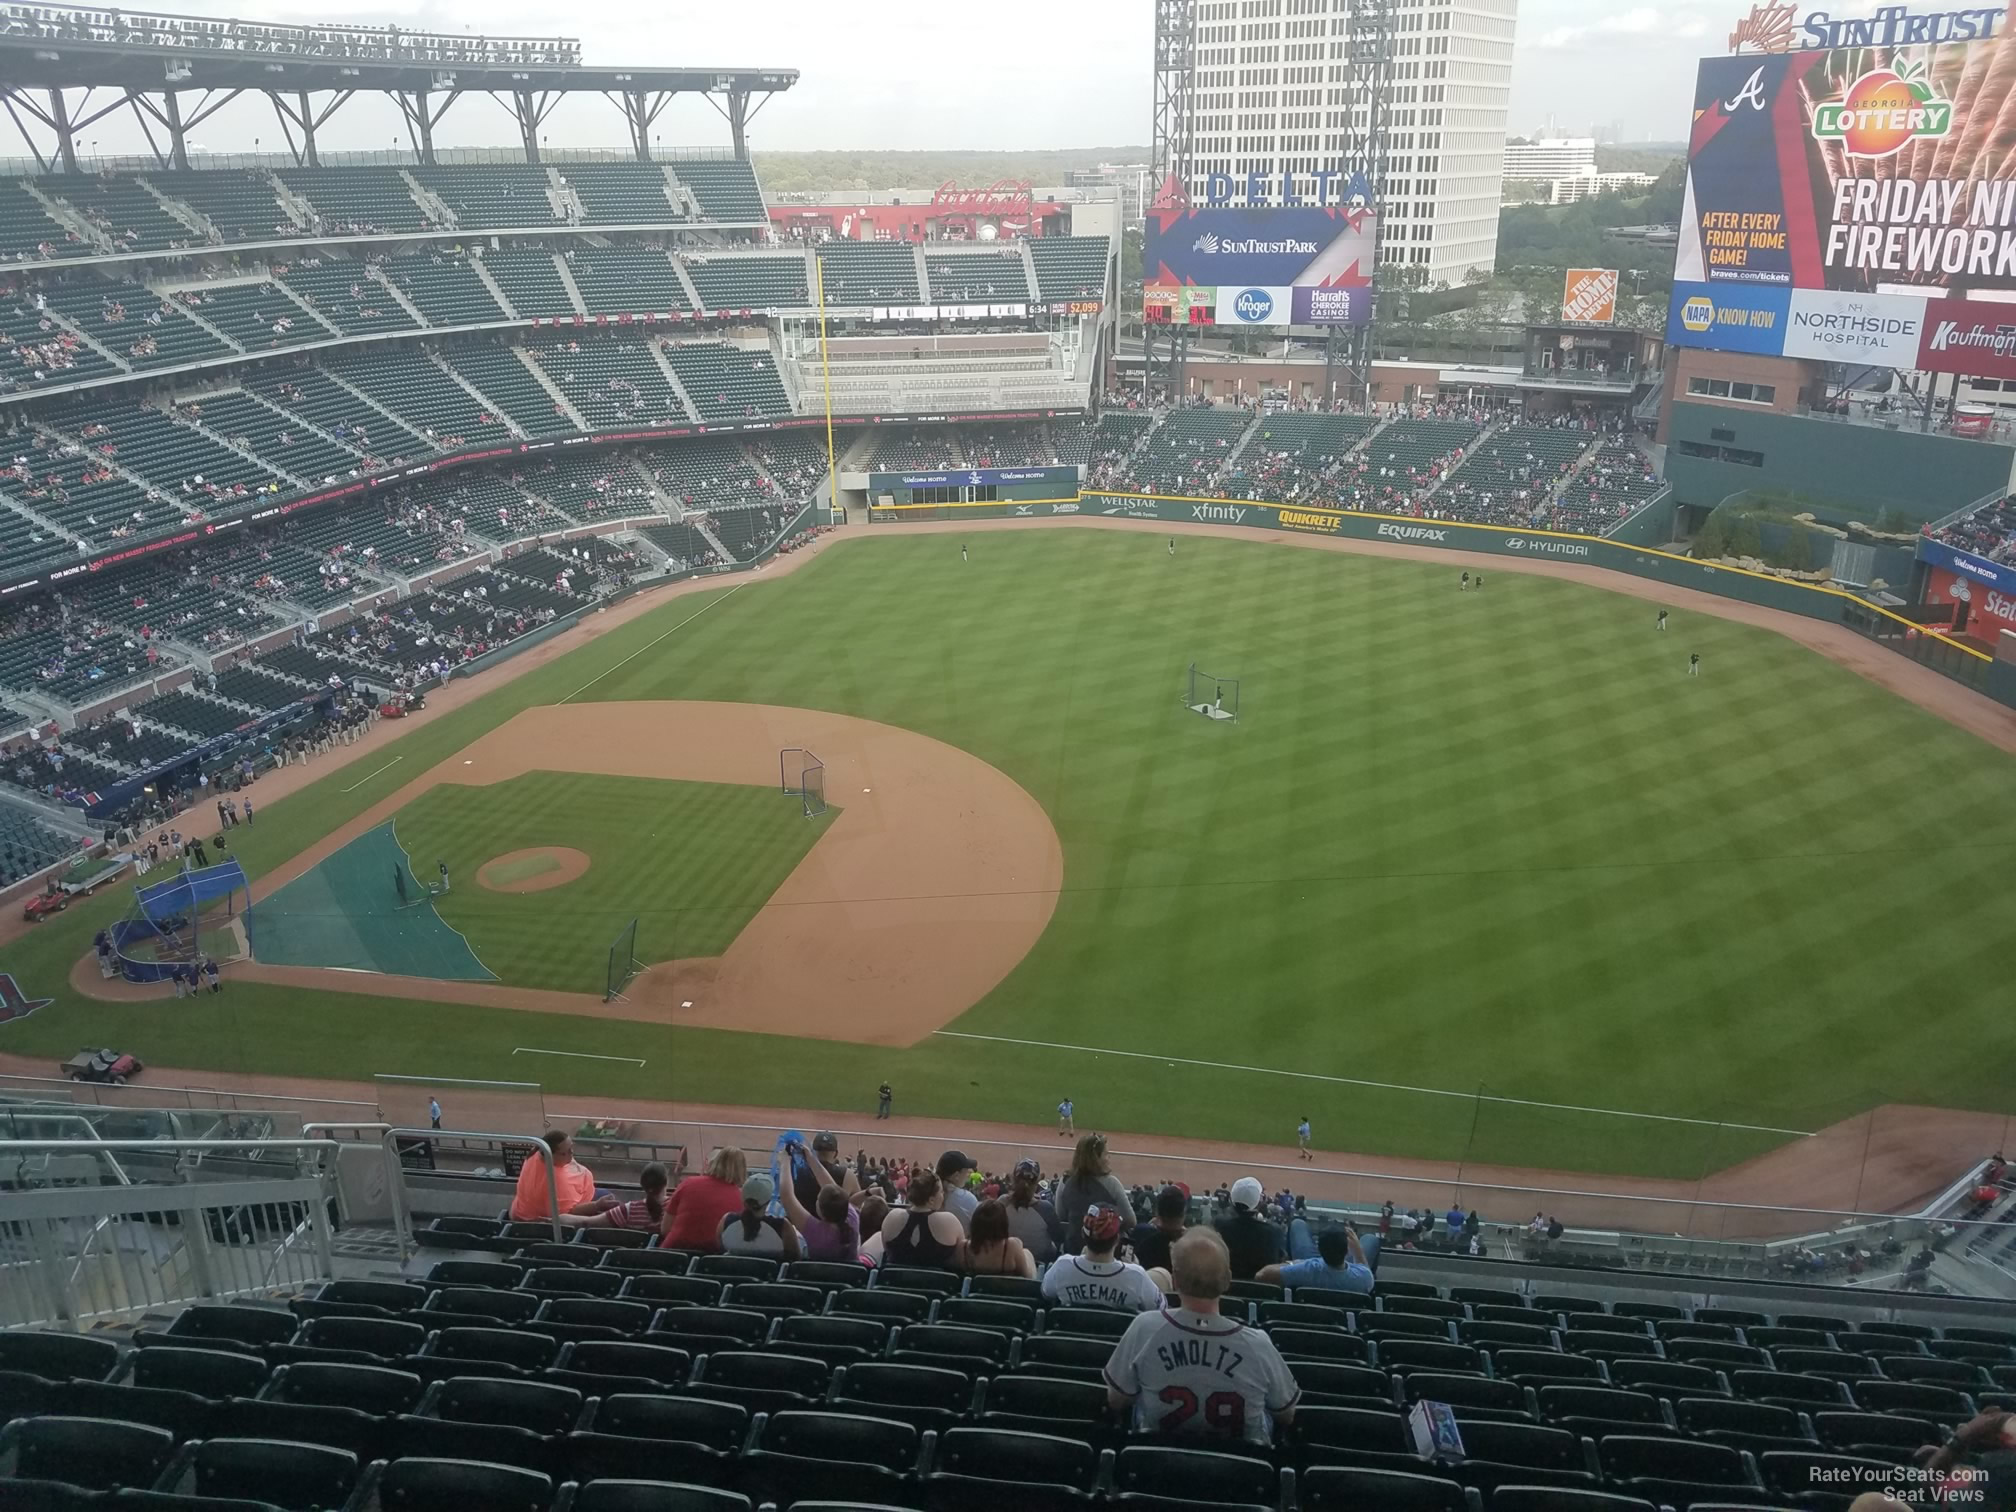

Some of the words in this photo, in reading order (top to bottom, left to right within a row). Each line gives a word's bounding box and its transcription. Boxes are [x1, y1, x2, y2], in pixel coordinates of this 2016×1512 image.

[1853, 100, 1914, 108] GEORGIA
[1821, 108, 1947, 131] LOTTERY
[1207, 170, 1375, 205] DELTA
[1832, 178, 1965, 225] FRIDAY
[1702, 211, 1739, 229] AFTER
[1741, 213, 1781, 230] EVERY
[1706, 230, 1748, 248] FRIDAY
[1749, 232, 1786, 249] HOME
[1709, 248, 1748, 266] GAME!
[1711, 269, 1790, 281] braves.com/tickets
[1570, 275, 1593, 295] THE
[1311, 290, 1350, 302] Harrah's
[1564, 270, 1616, 320] HOME
[1582, 289, 1615, 320] DEPOT
[765, 306, 778, 318] 42
[1029, 305, 1047, 314] 6:34
[1070, 302, 1098, 313] $2,099
[1238, 293, 1271, 319] Kroger
[1686, 305, 1710, 322] NAPA
[1716, 307, 1749, 326] KNOW
[1749, 310, 1776, 329] HOW
[1794, 311, 1916, 336] NORTHSIDE
[1812, 332, 1889, 348] HOSPITAL
[1192, 502, 1246, 523] xfinity
[1279, 510, 1342, 528] QUIKRETE
[1377, 523, 1446, 541] EQUIFAX
[1529, 540, 1588, 556] HYUNDAI
[50, 572, 62, 580] FOR
[63, 566, 80, 577] MORE
[1065, 1284, 1128, 1306] FREEMAN
[1157, 1340, 1243, 1379] SMOLTZ
[1158, 1385, 1245, 1438] 29
